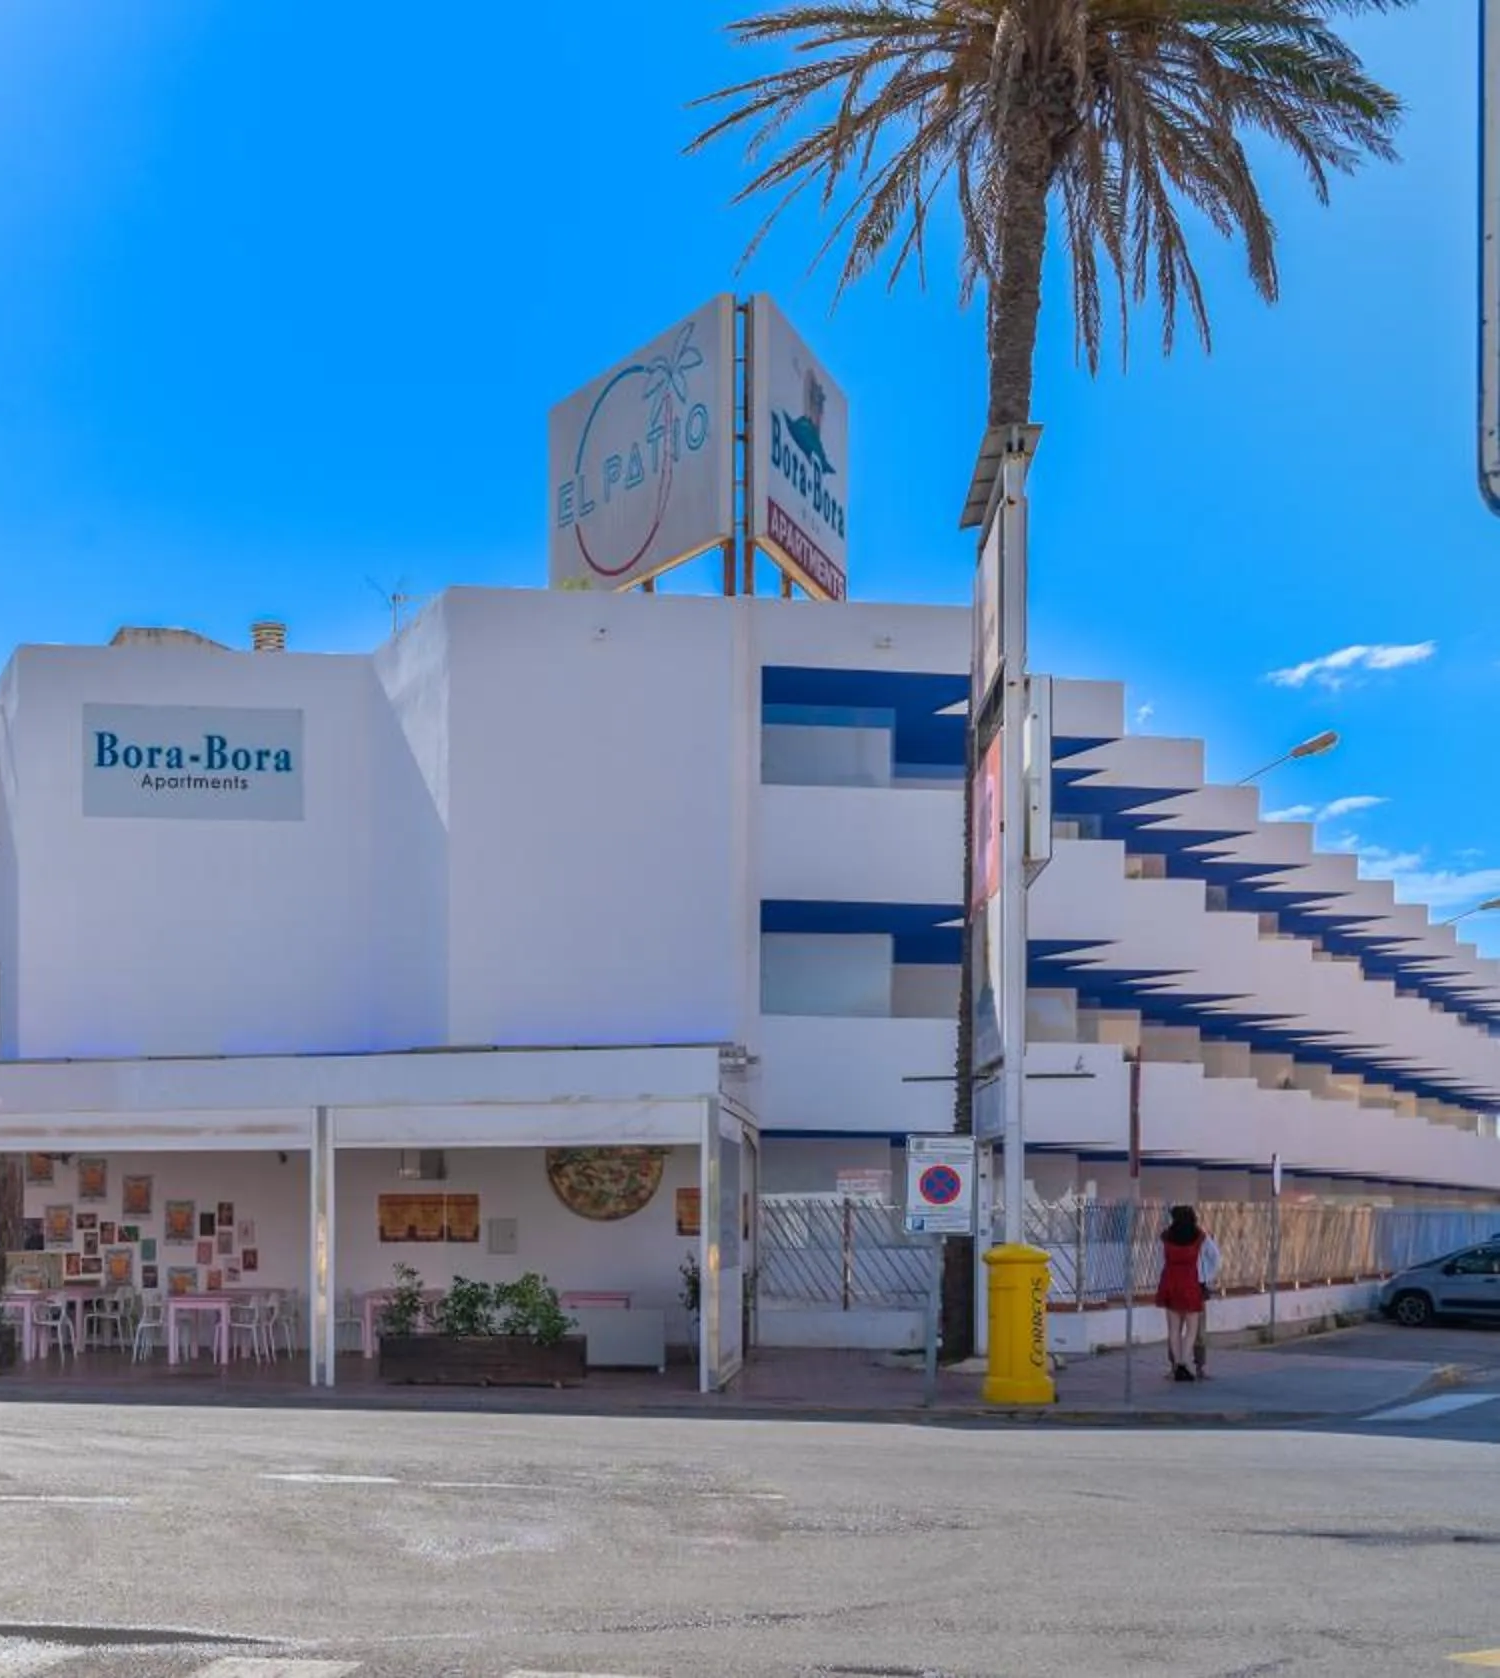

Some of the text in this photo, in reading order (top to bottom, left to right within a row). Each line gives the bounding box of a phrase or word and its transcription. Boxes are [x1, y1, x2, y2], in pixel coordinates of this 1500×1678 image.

[558, 403, 709, 528] EL PATIO
[771, 408, 845, 540] Bora-Bora
[770, 508, 845, 600] APARTMENTS
[94, 731, 293, 773] Bora-Bora
[140, 773, 249, 791] Apartments
[1030, 1277, 1044, 1367] CORREOS
